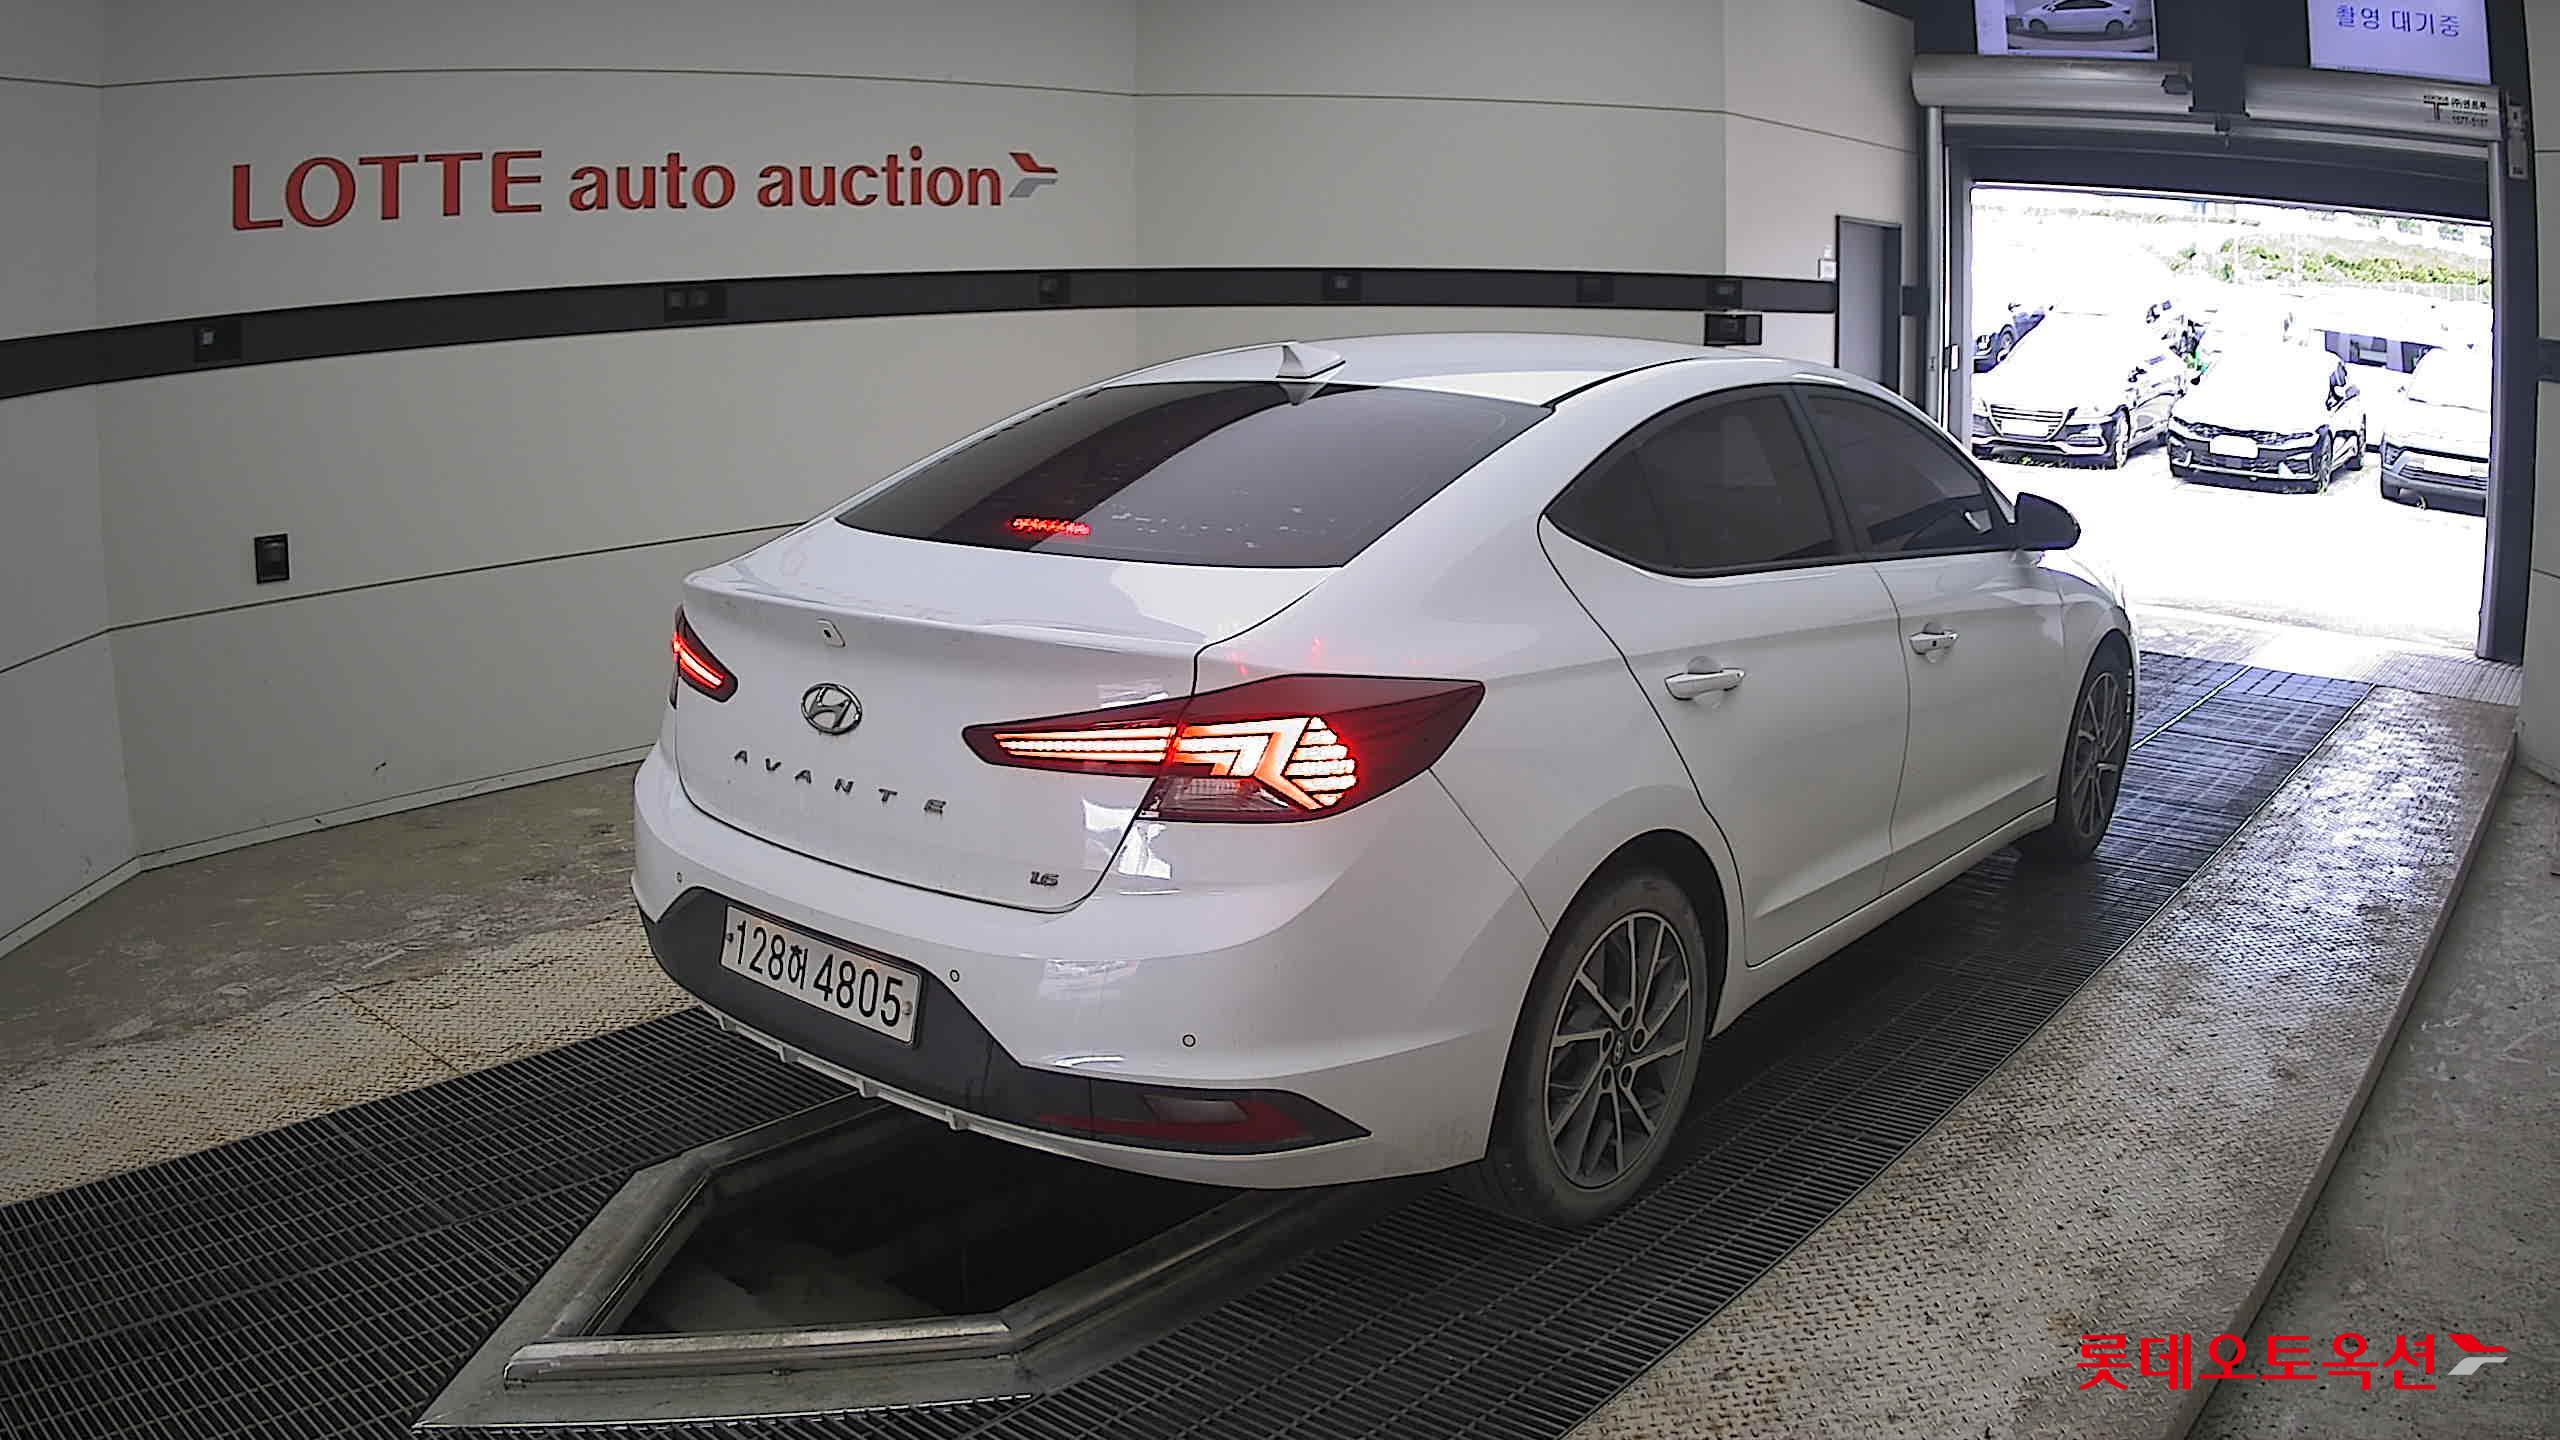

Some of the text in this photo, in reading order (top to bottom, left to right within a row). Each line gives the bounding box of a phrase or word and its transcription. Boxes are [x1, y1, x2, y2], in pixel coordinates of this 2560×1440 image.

[2336, 5, 2460, 37] 촬영 대기중
[232, 145, 1001, 230] LOTTE auto auction
[734, 750, 946, 815] AVANTE
